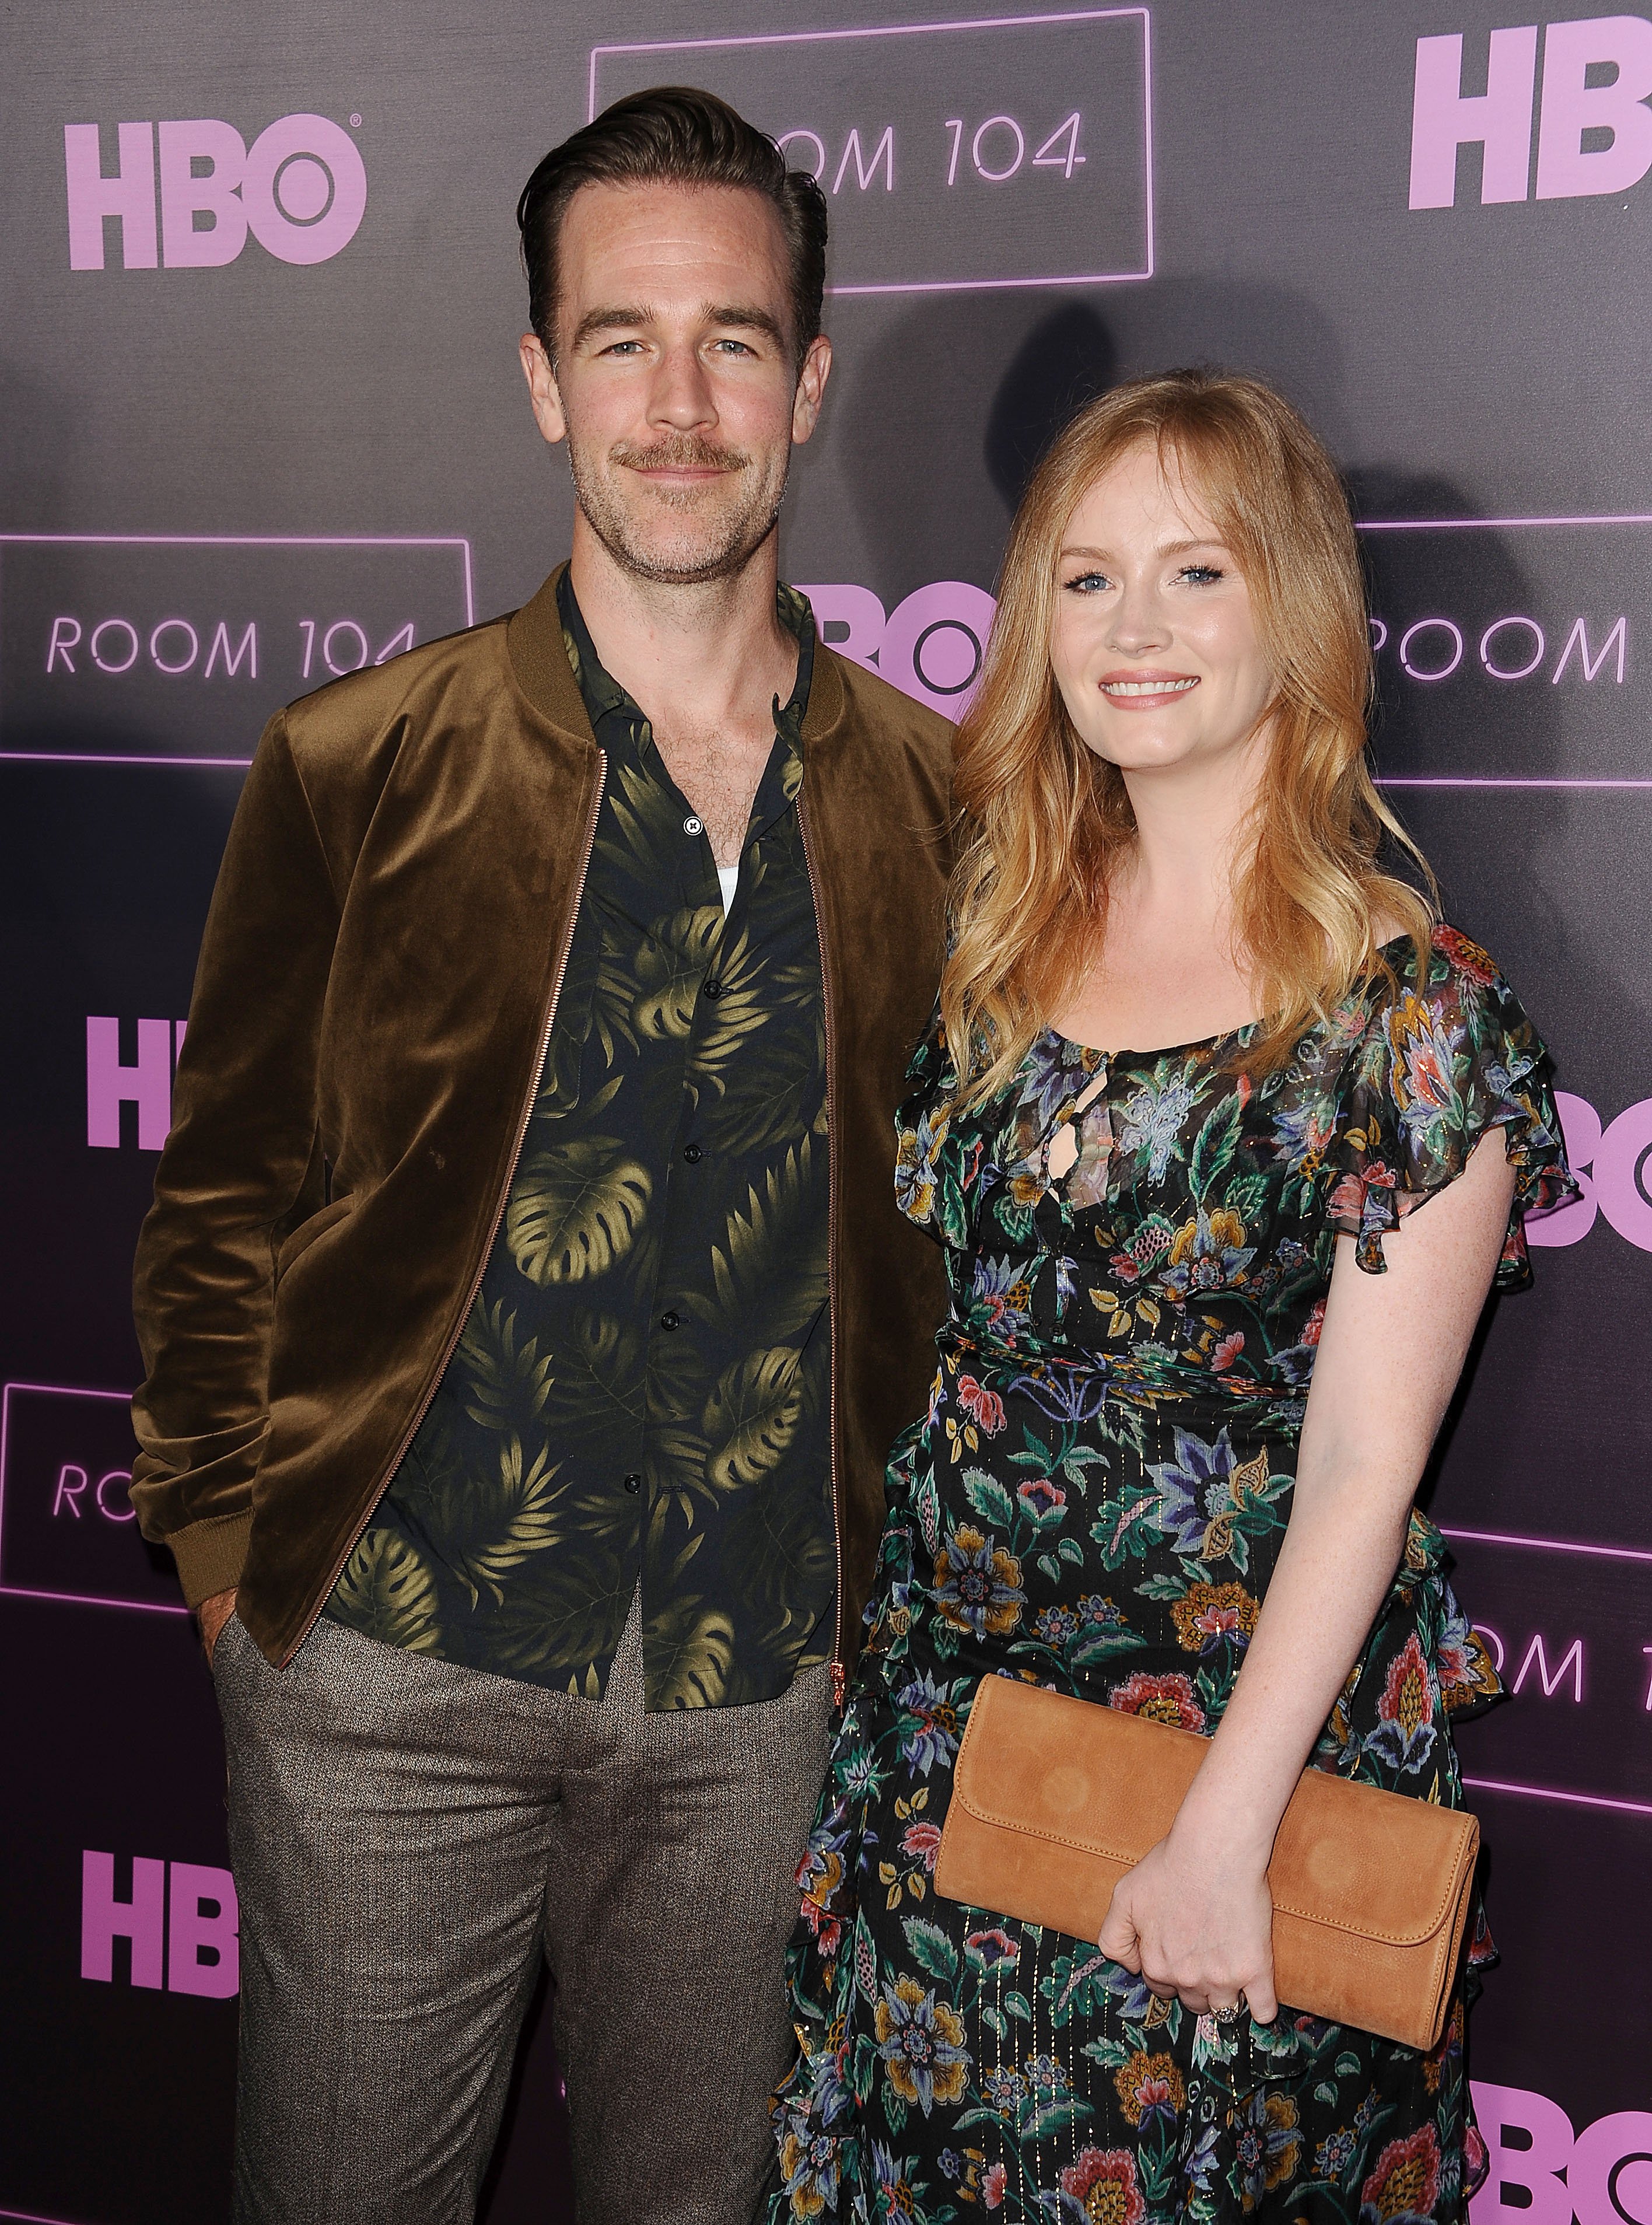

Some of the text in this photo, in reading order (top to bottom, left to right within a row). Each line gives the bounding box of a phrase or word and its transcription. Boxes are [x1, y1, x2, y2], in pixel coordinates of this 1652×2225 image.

[945, 113, 1086, 187] 104
[1409, 15, 1652, 209] HB
[47, 617, 257, 678] ROOM
[87, 1016, 188, 1150] H
[80, 1849, 239, 1999] HB
